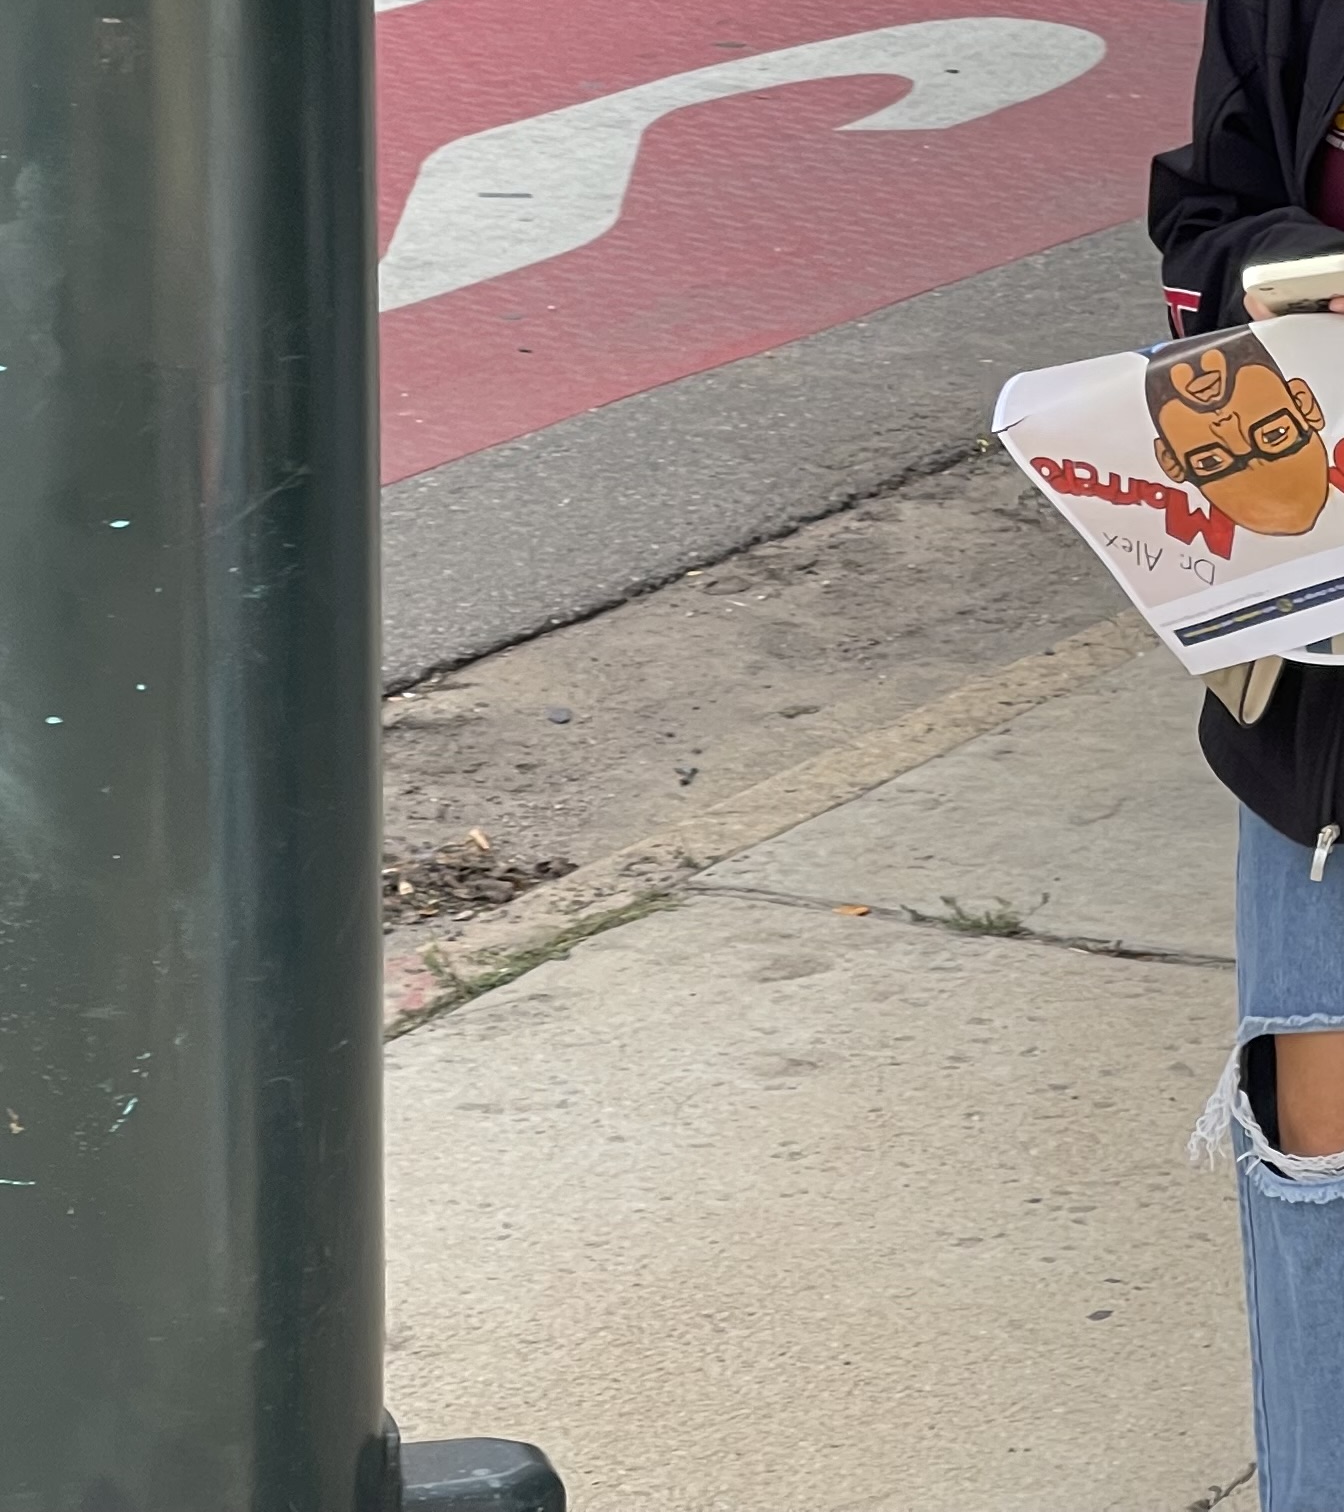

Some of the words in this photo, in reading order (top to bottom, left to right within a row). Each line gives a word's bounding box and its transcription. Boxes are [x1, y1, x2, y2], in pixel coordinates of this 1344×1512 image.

[1029, 456, 1236, 560] Morrero
[1103, 531, 1163, 571] Alex
[1180, 551, 1217, 586] Dr.
